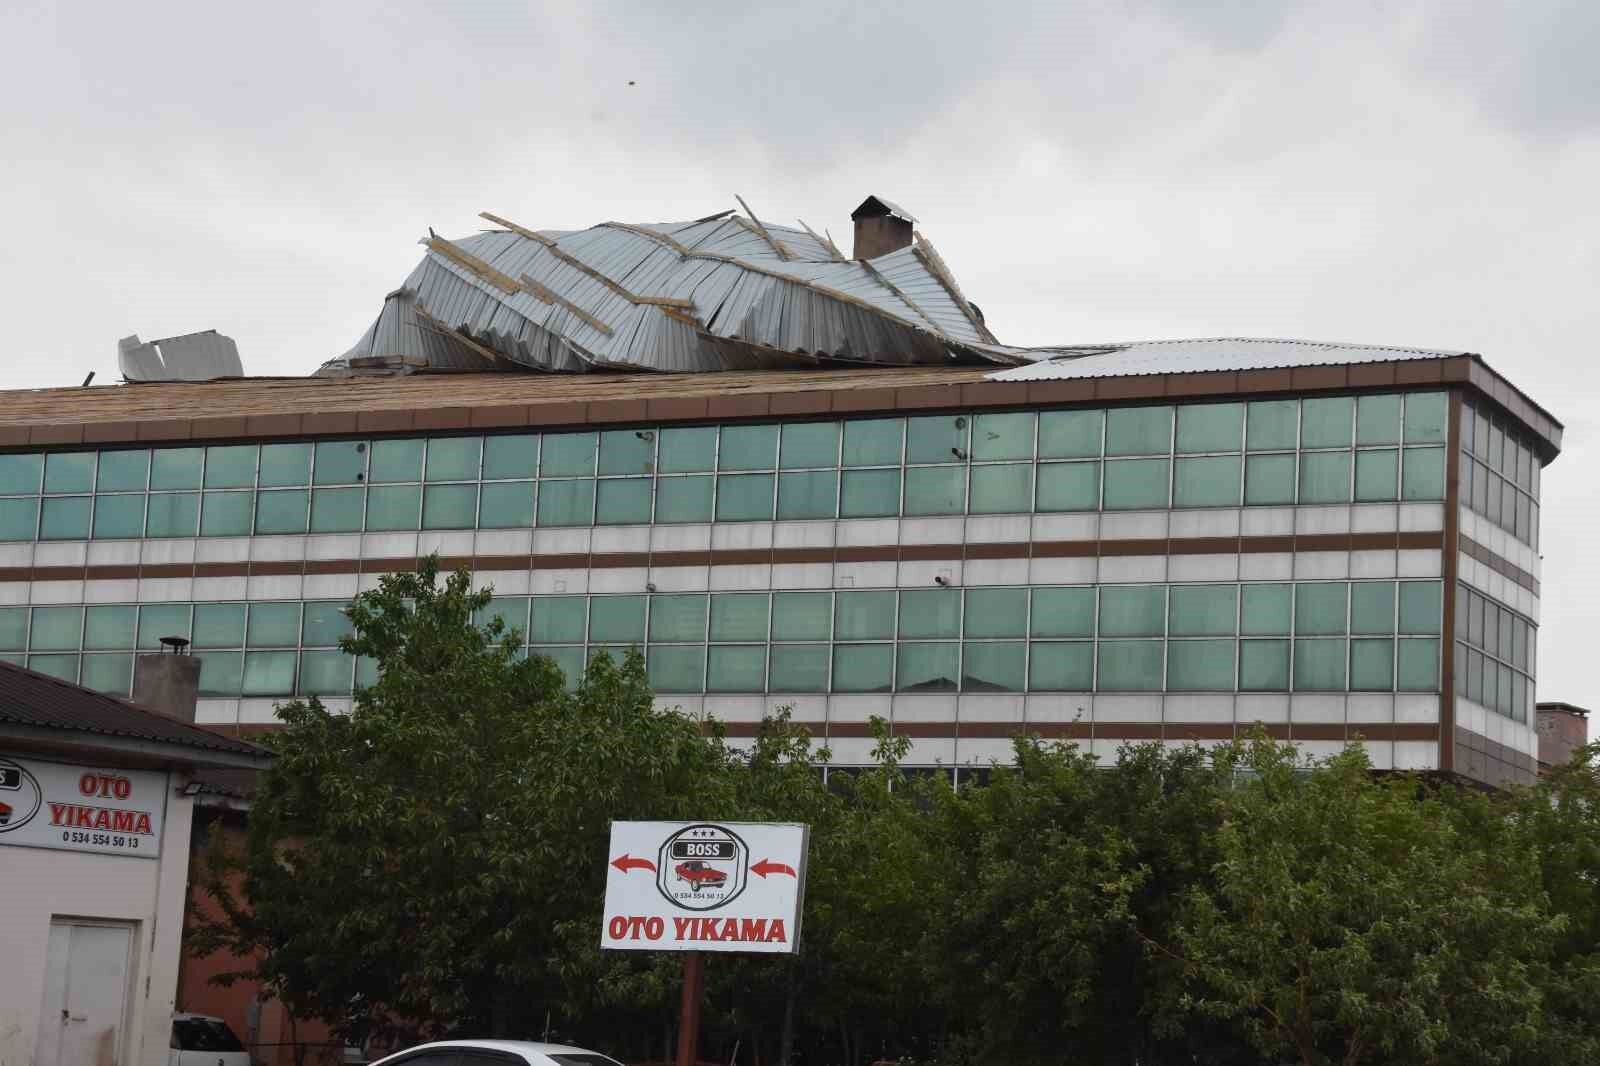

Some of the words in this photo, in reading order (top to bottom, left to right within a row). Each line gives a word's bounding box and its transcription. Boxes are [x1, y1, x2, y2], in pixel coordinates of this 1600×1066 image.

[79, 773, 131, 799] OTO
[48, 802, 154, 835] YIKAMA
[63, 832, 69, 842] 0
[72, 832, 90, 844] 534
[92, 835, 109, 846] 554
[112, 836, 124, 847] 50
[128, 838, 138, 848] 13
[687, 844, 720, 856] BOSS
[608, 916, 665, 940] OTO
[672, 917, 787, 943] YIKAMA
